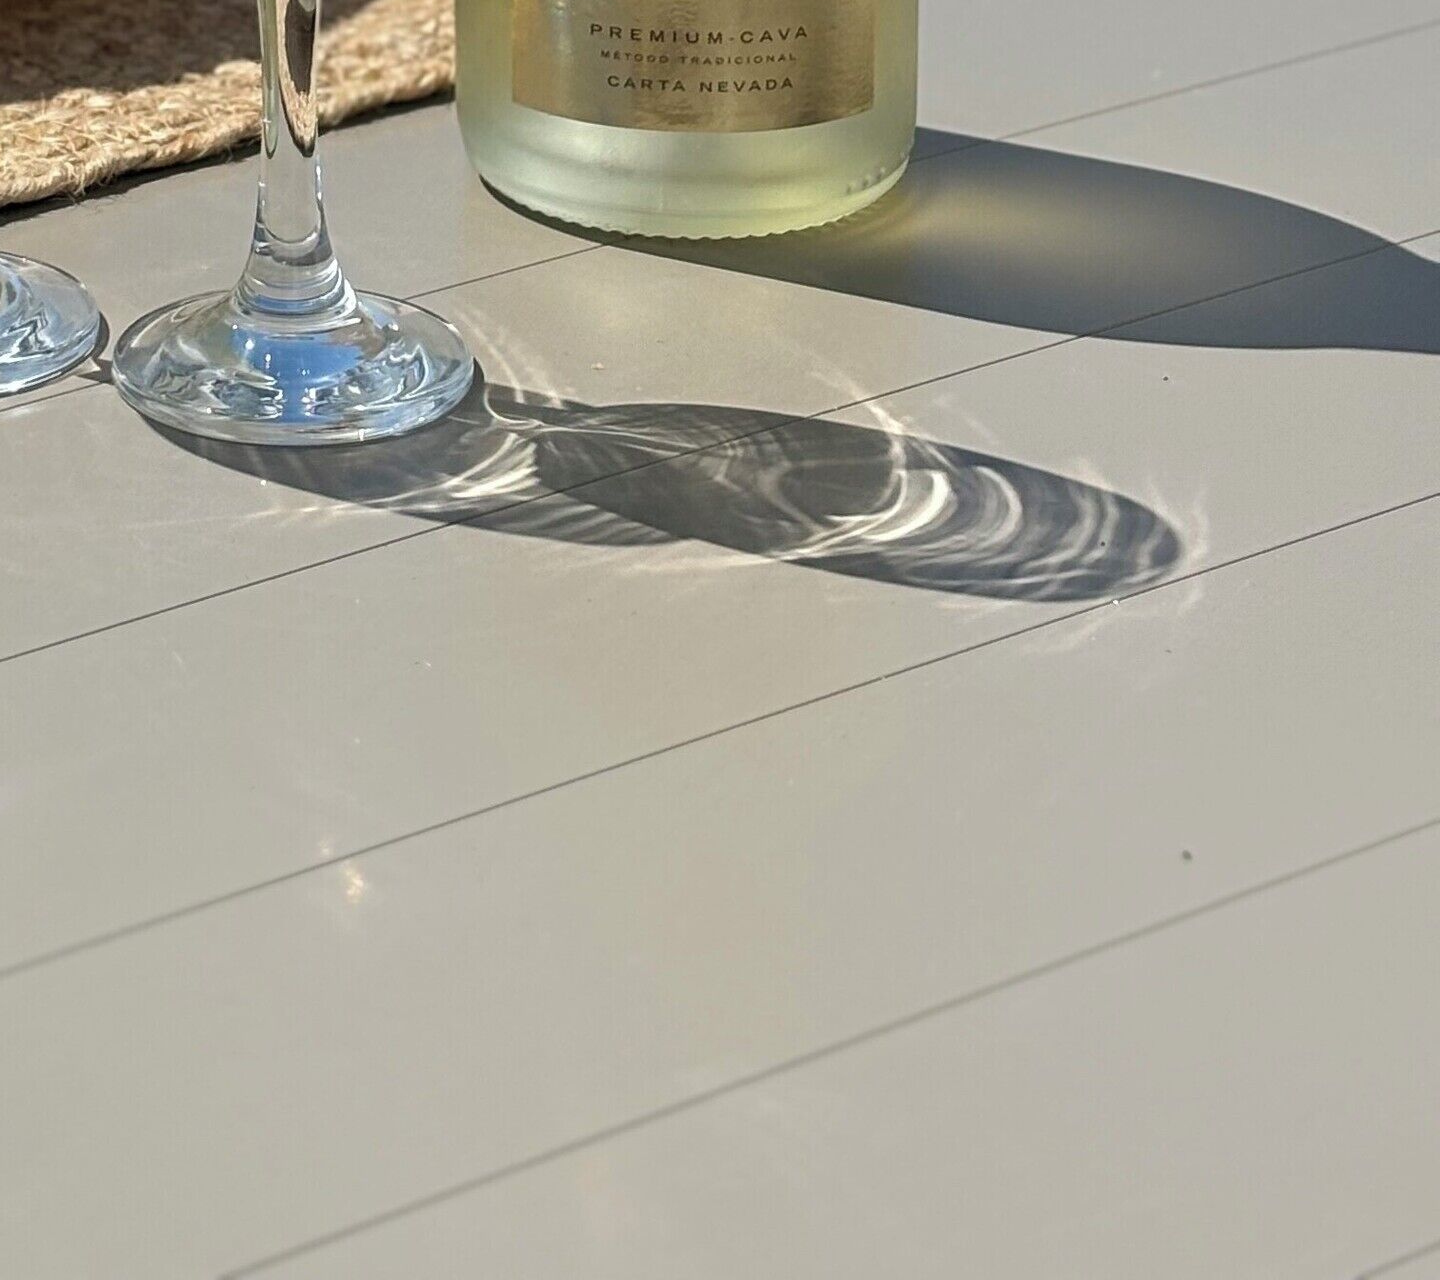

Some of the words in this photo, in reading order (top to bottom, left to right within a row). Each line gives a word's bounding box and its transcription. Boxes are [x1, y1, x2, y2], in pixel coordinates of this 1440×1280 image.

[679, 52, 797, 65] TRADICIONAL
[607, 75, 686, 92] CARTA
[699, 76, 794, 93] NEVADA
